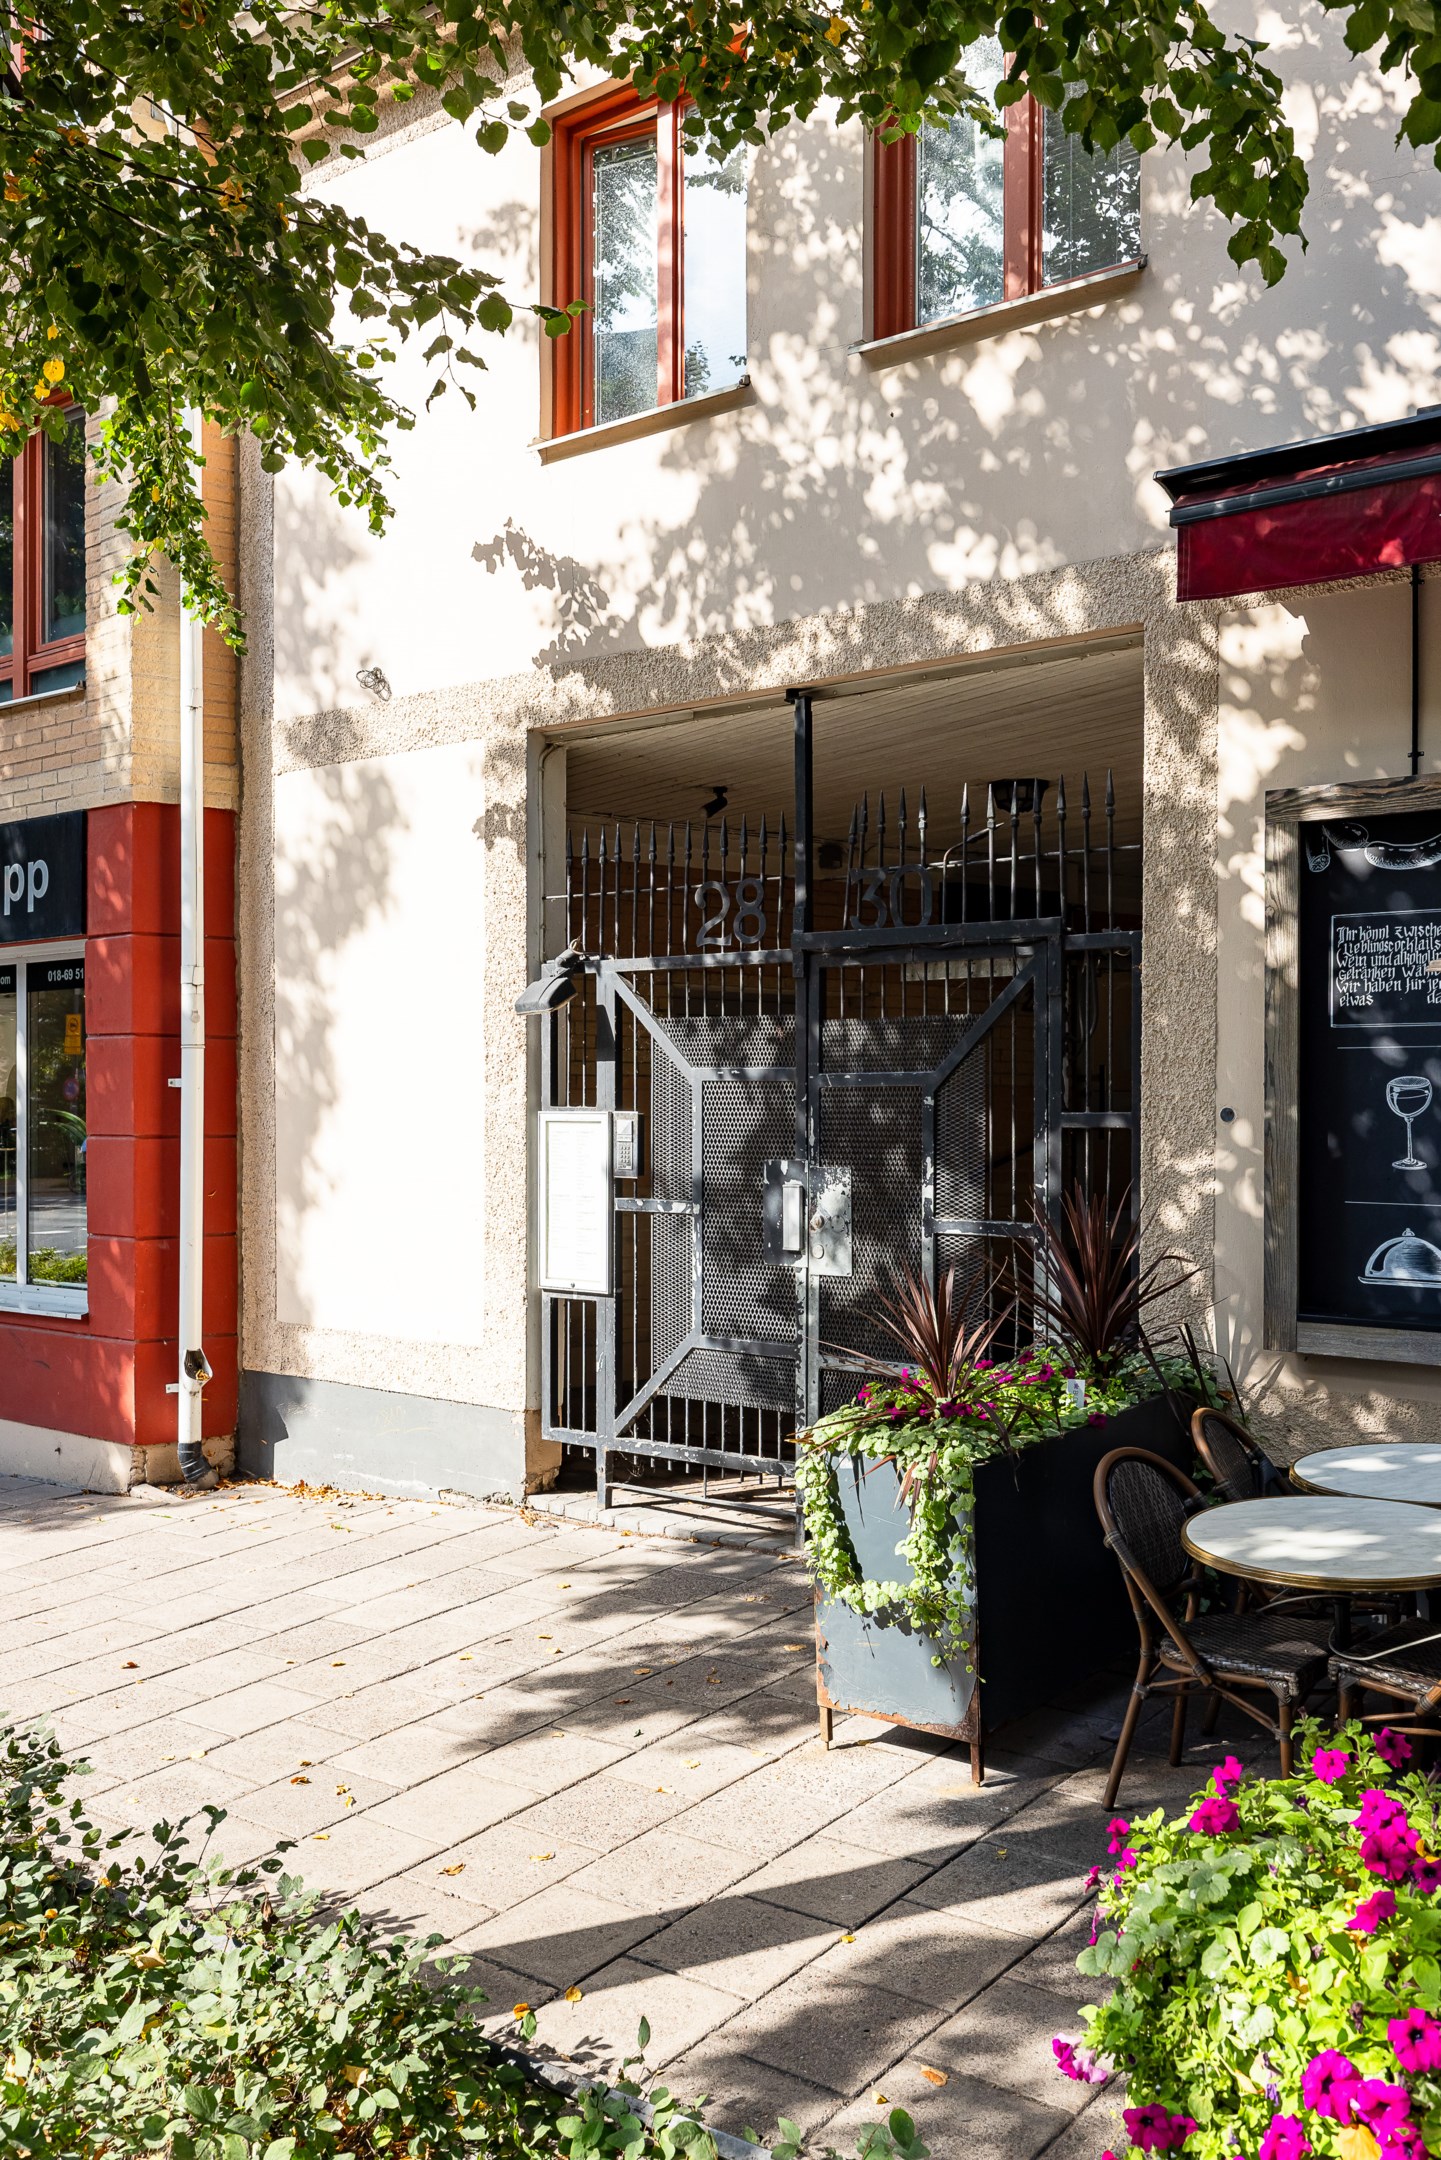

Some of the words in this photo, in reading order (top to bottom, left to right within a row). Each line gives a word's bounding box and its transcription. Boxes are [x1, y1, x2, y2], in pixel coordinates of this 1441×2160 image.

[3, 859, 49, 916] pp
[850, 864, 933, 928] 30
[694, 877, 767, 947] 28
[1337, 926, 1358, 947] Ihr
[1371, 951, 1394, 967] und
[47, 968, 74, 982] 018-69
[75, 967, 84, 980] 51
[1364, 978, 1402, 995] haben
[1404, 976, 1426, 994] für
[1339, 992, 1374, 1007] etwas
